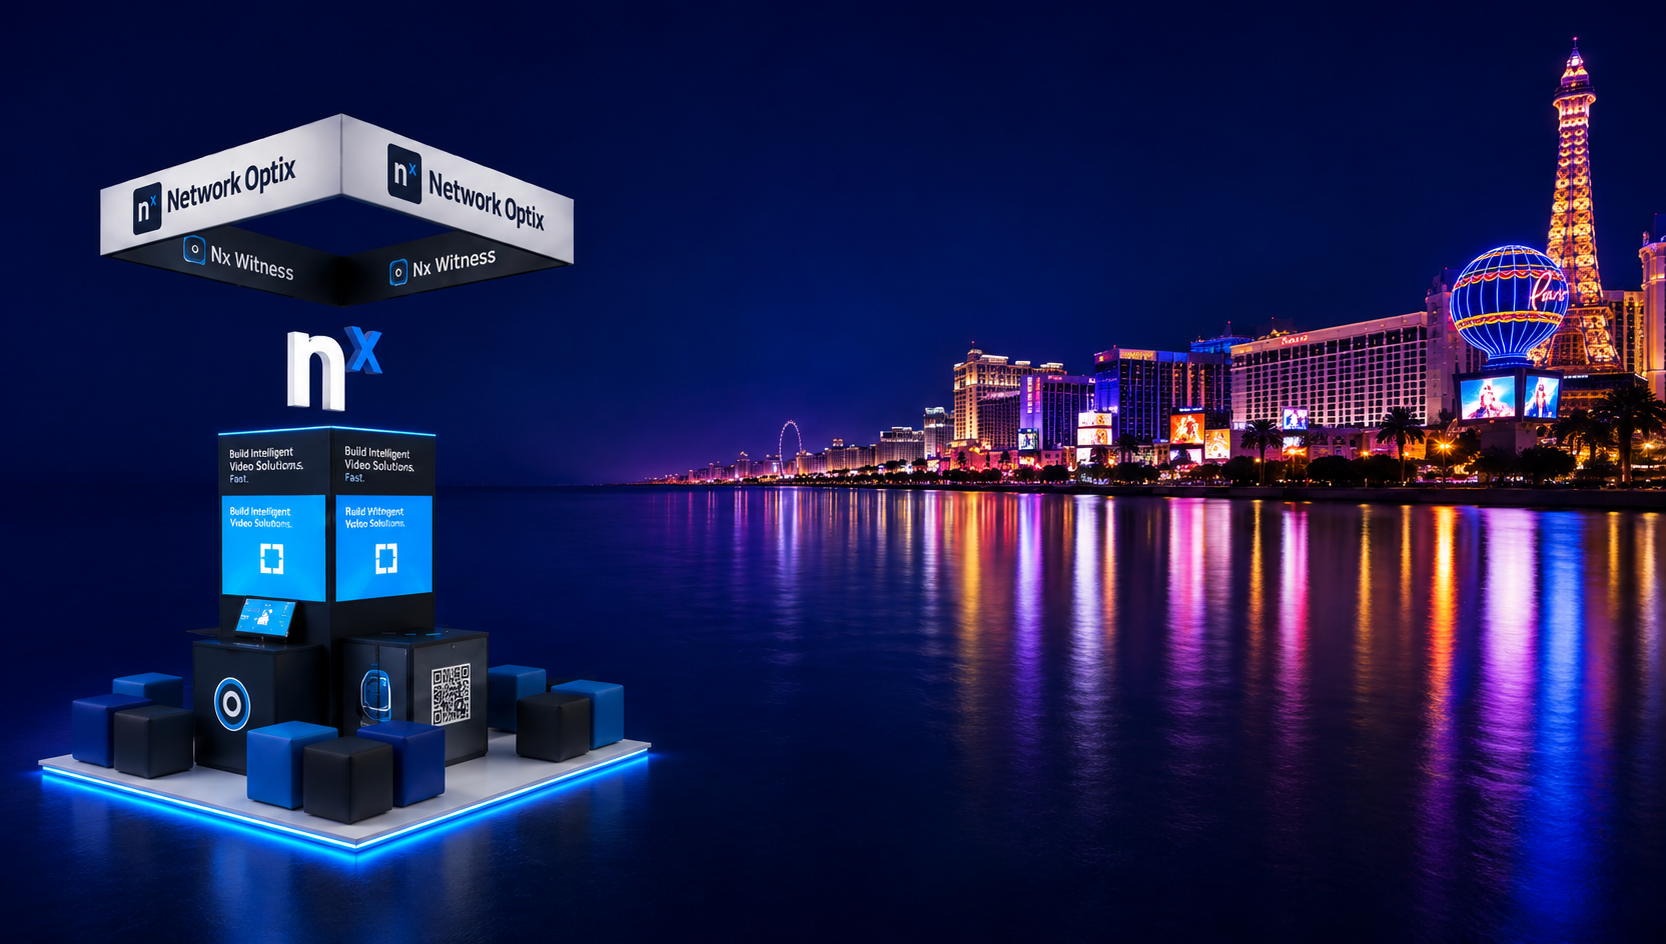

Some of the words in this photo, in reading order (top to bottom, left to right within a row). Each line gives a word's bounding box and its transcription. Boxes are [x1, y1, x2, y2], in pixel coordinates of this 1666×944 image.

[167, 169, 241, 213] Network
[244, 156, 296, 190] Optix
[428, 169, 502, 217] Network
[505, 195, 545, 232] Optix
[211, 245, 231, 267] Nx
[234, 249, 294, 281] Witness
[412, 260, 432, 278] Nx
[435, 248, 497, 274] Witness
[229, 450, 249, 459] Build
[250, 447, 293, 460] Intelligent
[344, 446, 367, 458] Build
[369, 448, 411, 461] Intelligent
[229, 461, 254, 471] Video
[344, 459, 371, 470] Video
[344, 472, 366, 483] Fast.
[230, 507, 250, 516] Build
